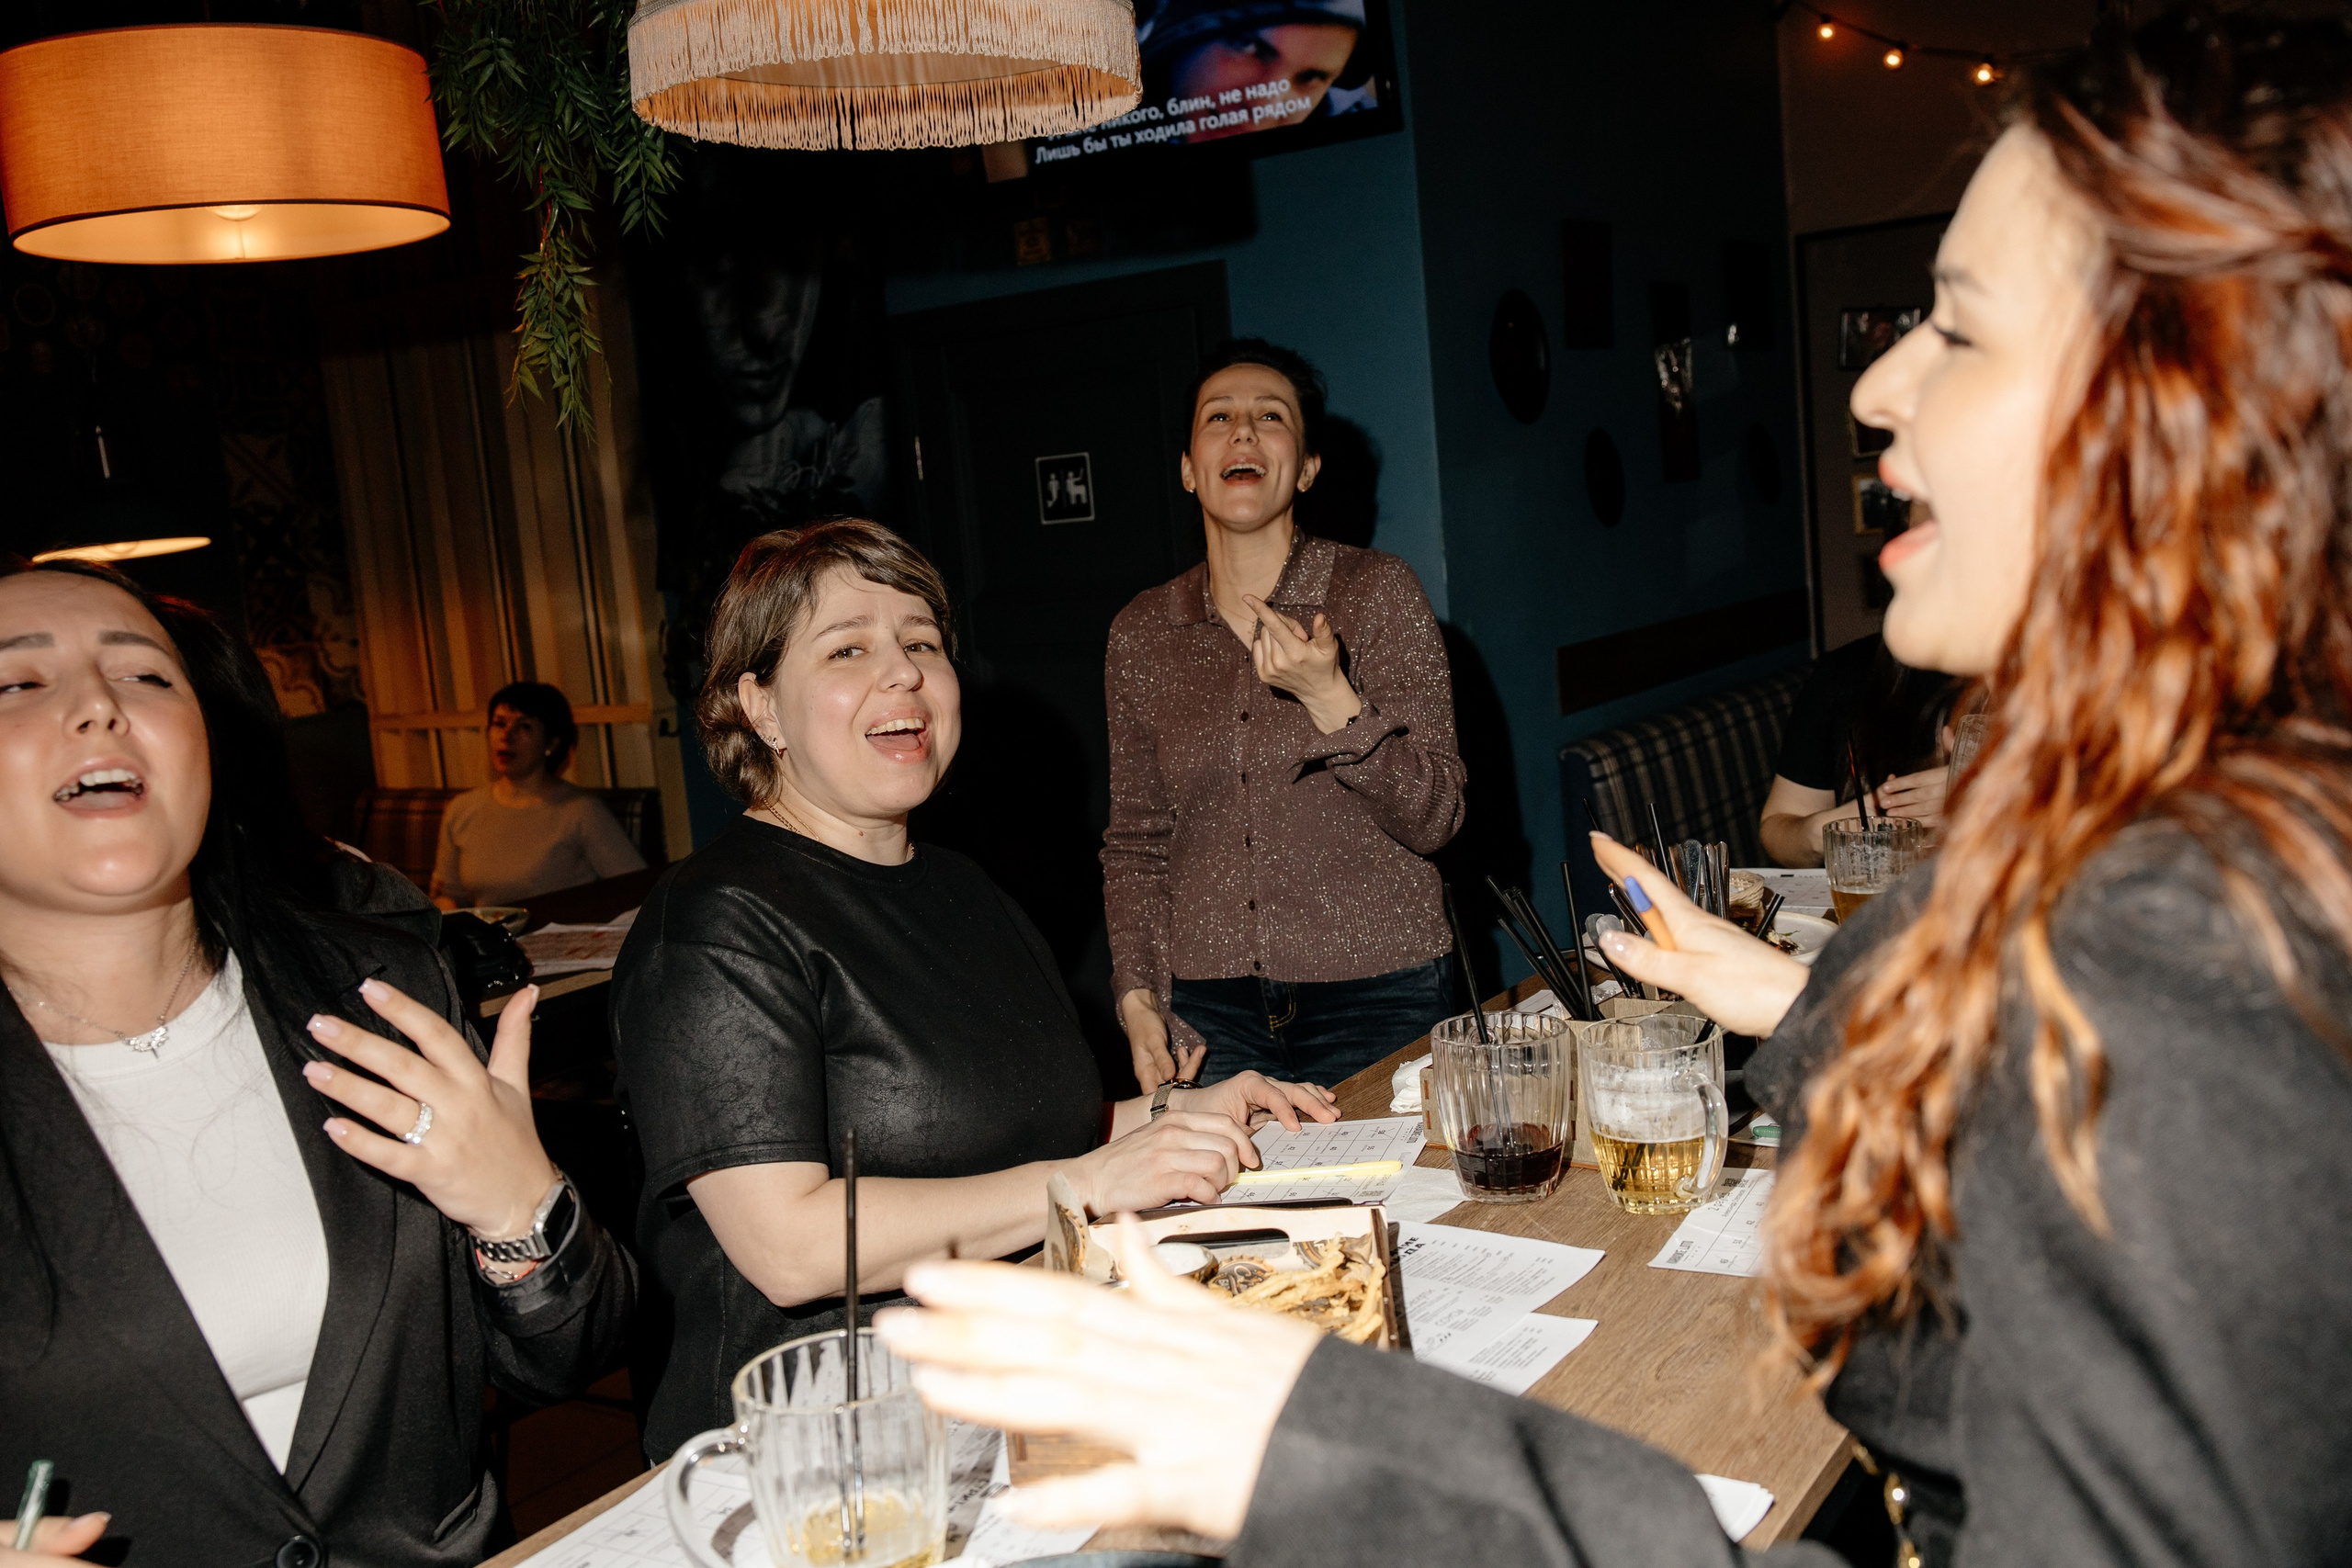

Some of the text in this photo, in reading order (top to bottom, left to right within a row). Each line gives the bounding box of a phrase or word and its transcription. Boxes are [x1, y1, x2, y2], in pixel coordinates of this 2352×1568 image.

[1167, 95, 1216, 117] блин,
[1219, 88, 1241, 106] не
[1244, 78, 1291, 100] надо
[1035, 96, 1312, 165] Лишь бы ты ходила голая рядом
